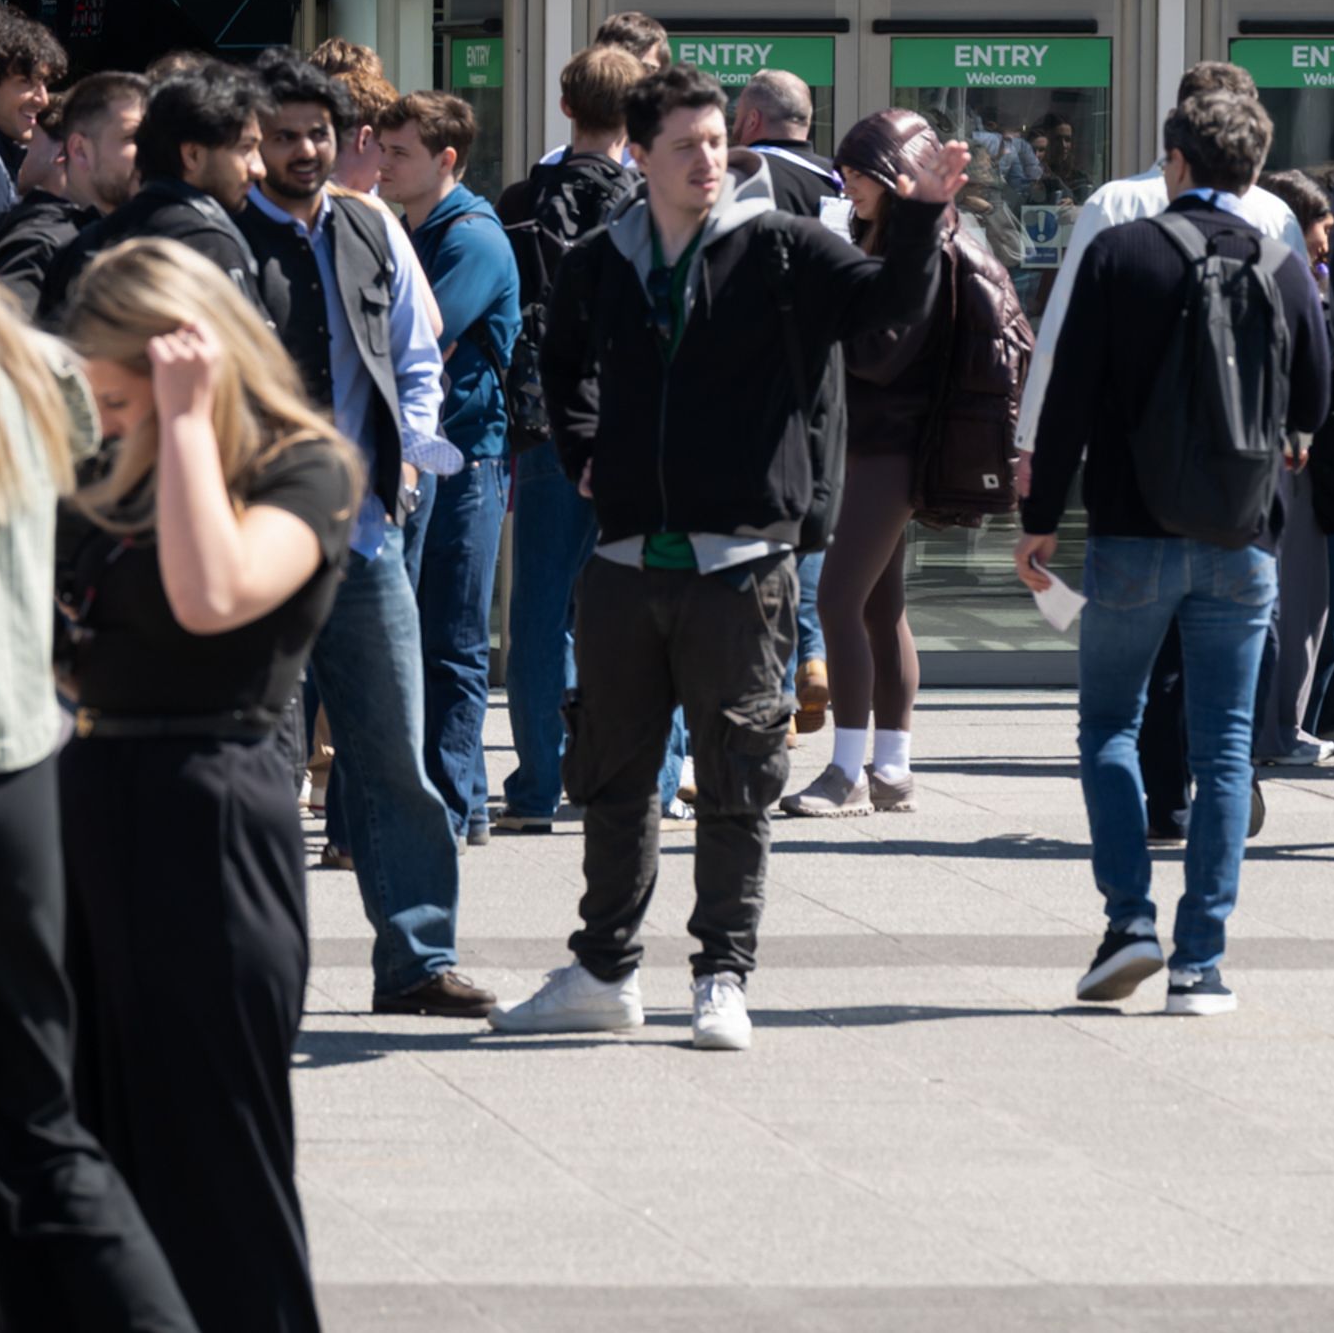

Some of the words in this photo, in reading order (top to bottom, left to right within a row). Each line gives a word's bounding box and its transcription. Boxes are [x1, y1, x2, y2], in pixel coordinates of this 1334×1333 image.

[467, 45, 491, 67] ENTRY
[679, 43, 773, 65] ENTRY
[954, 45, 1048, 67] ENTRY
[965, 71, 1036, 85] Welcome
